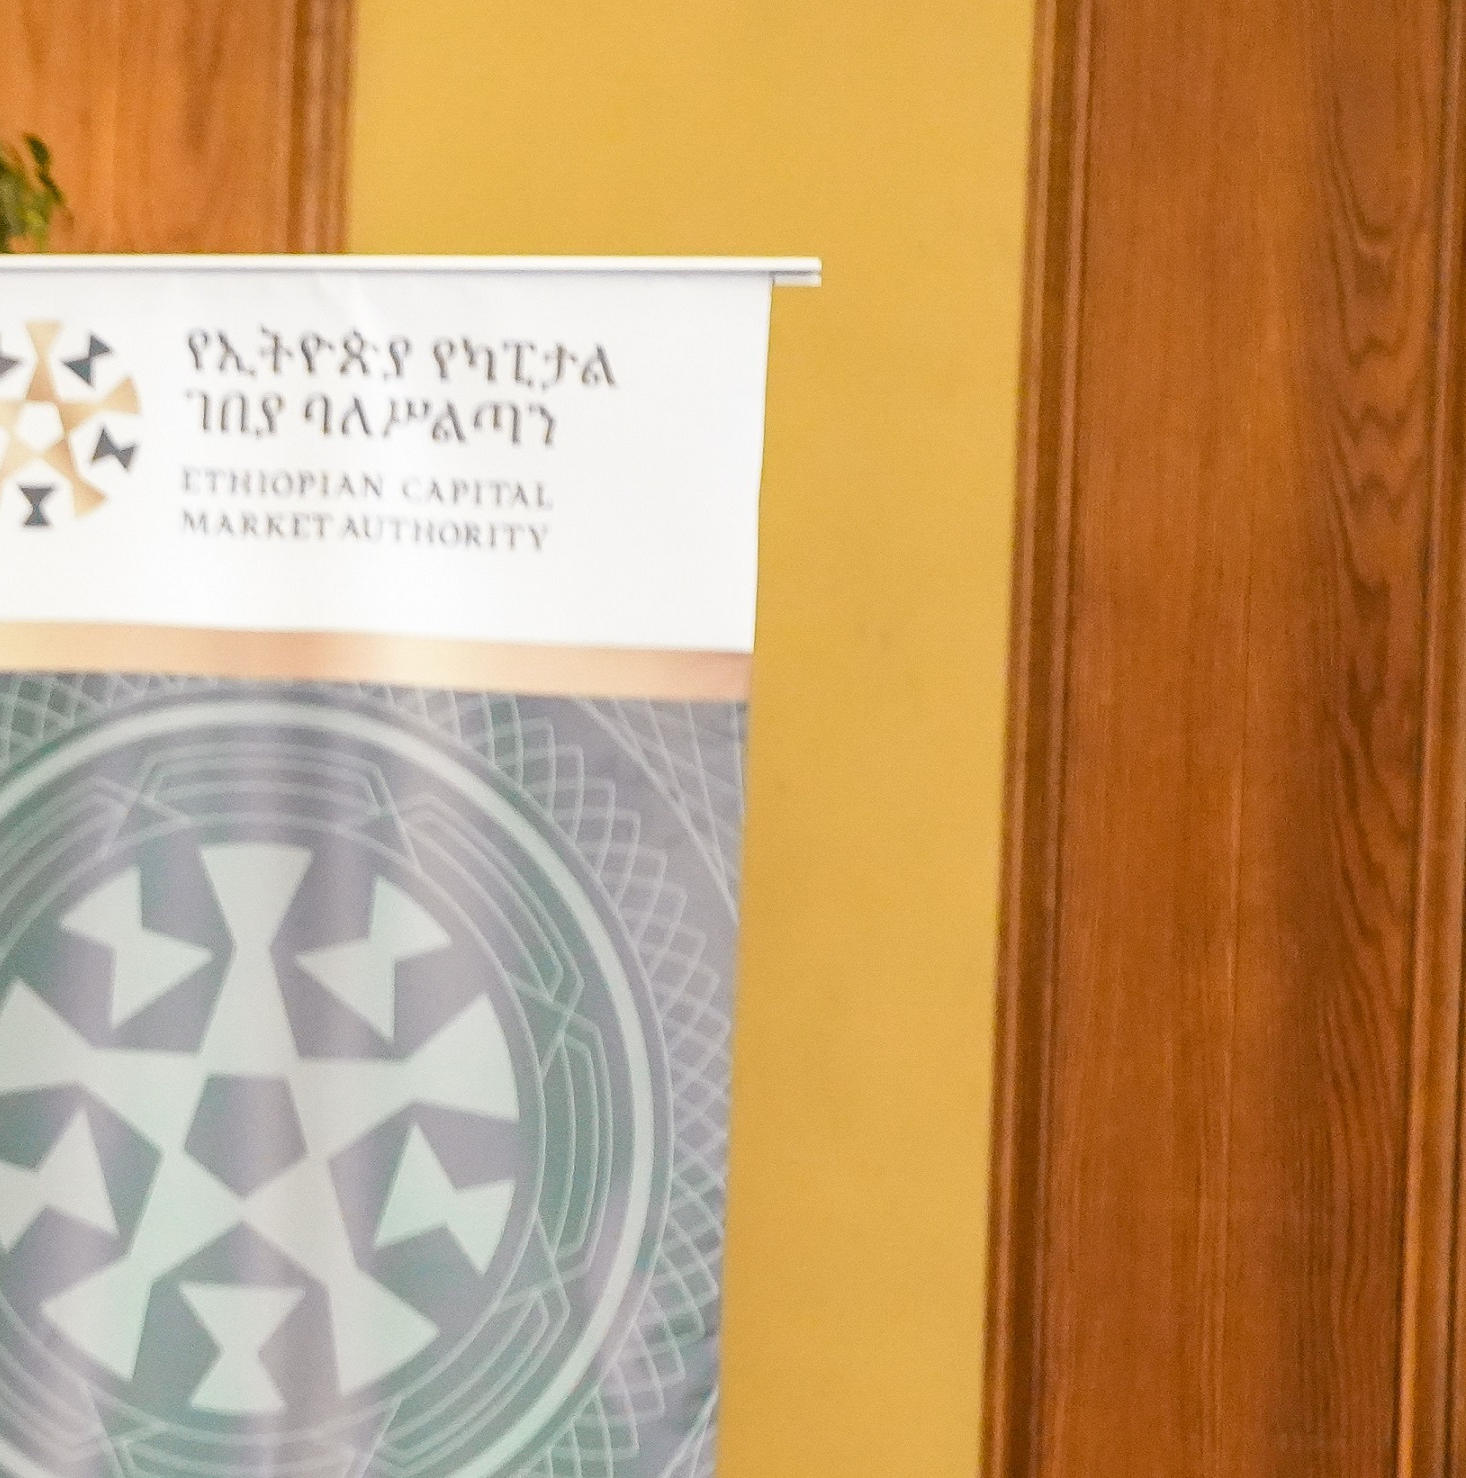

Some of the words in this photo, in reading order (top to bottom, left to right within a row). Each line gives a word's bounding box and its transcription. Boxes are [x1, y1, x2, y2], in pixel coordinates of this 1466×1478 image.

[431, 336, 618, 390] የካፒታል
[186, 389, 285, 439] ገበያ
[182, 466, 384, 500] ETHIOPIAN
[401, 477, 554, 511] CAPITAL
[182, 510, 334, 540] MARKET
[341, 512, 550, 552] AUTHORITY
